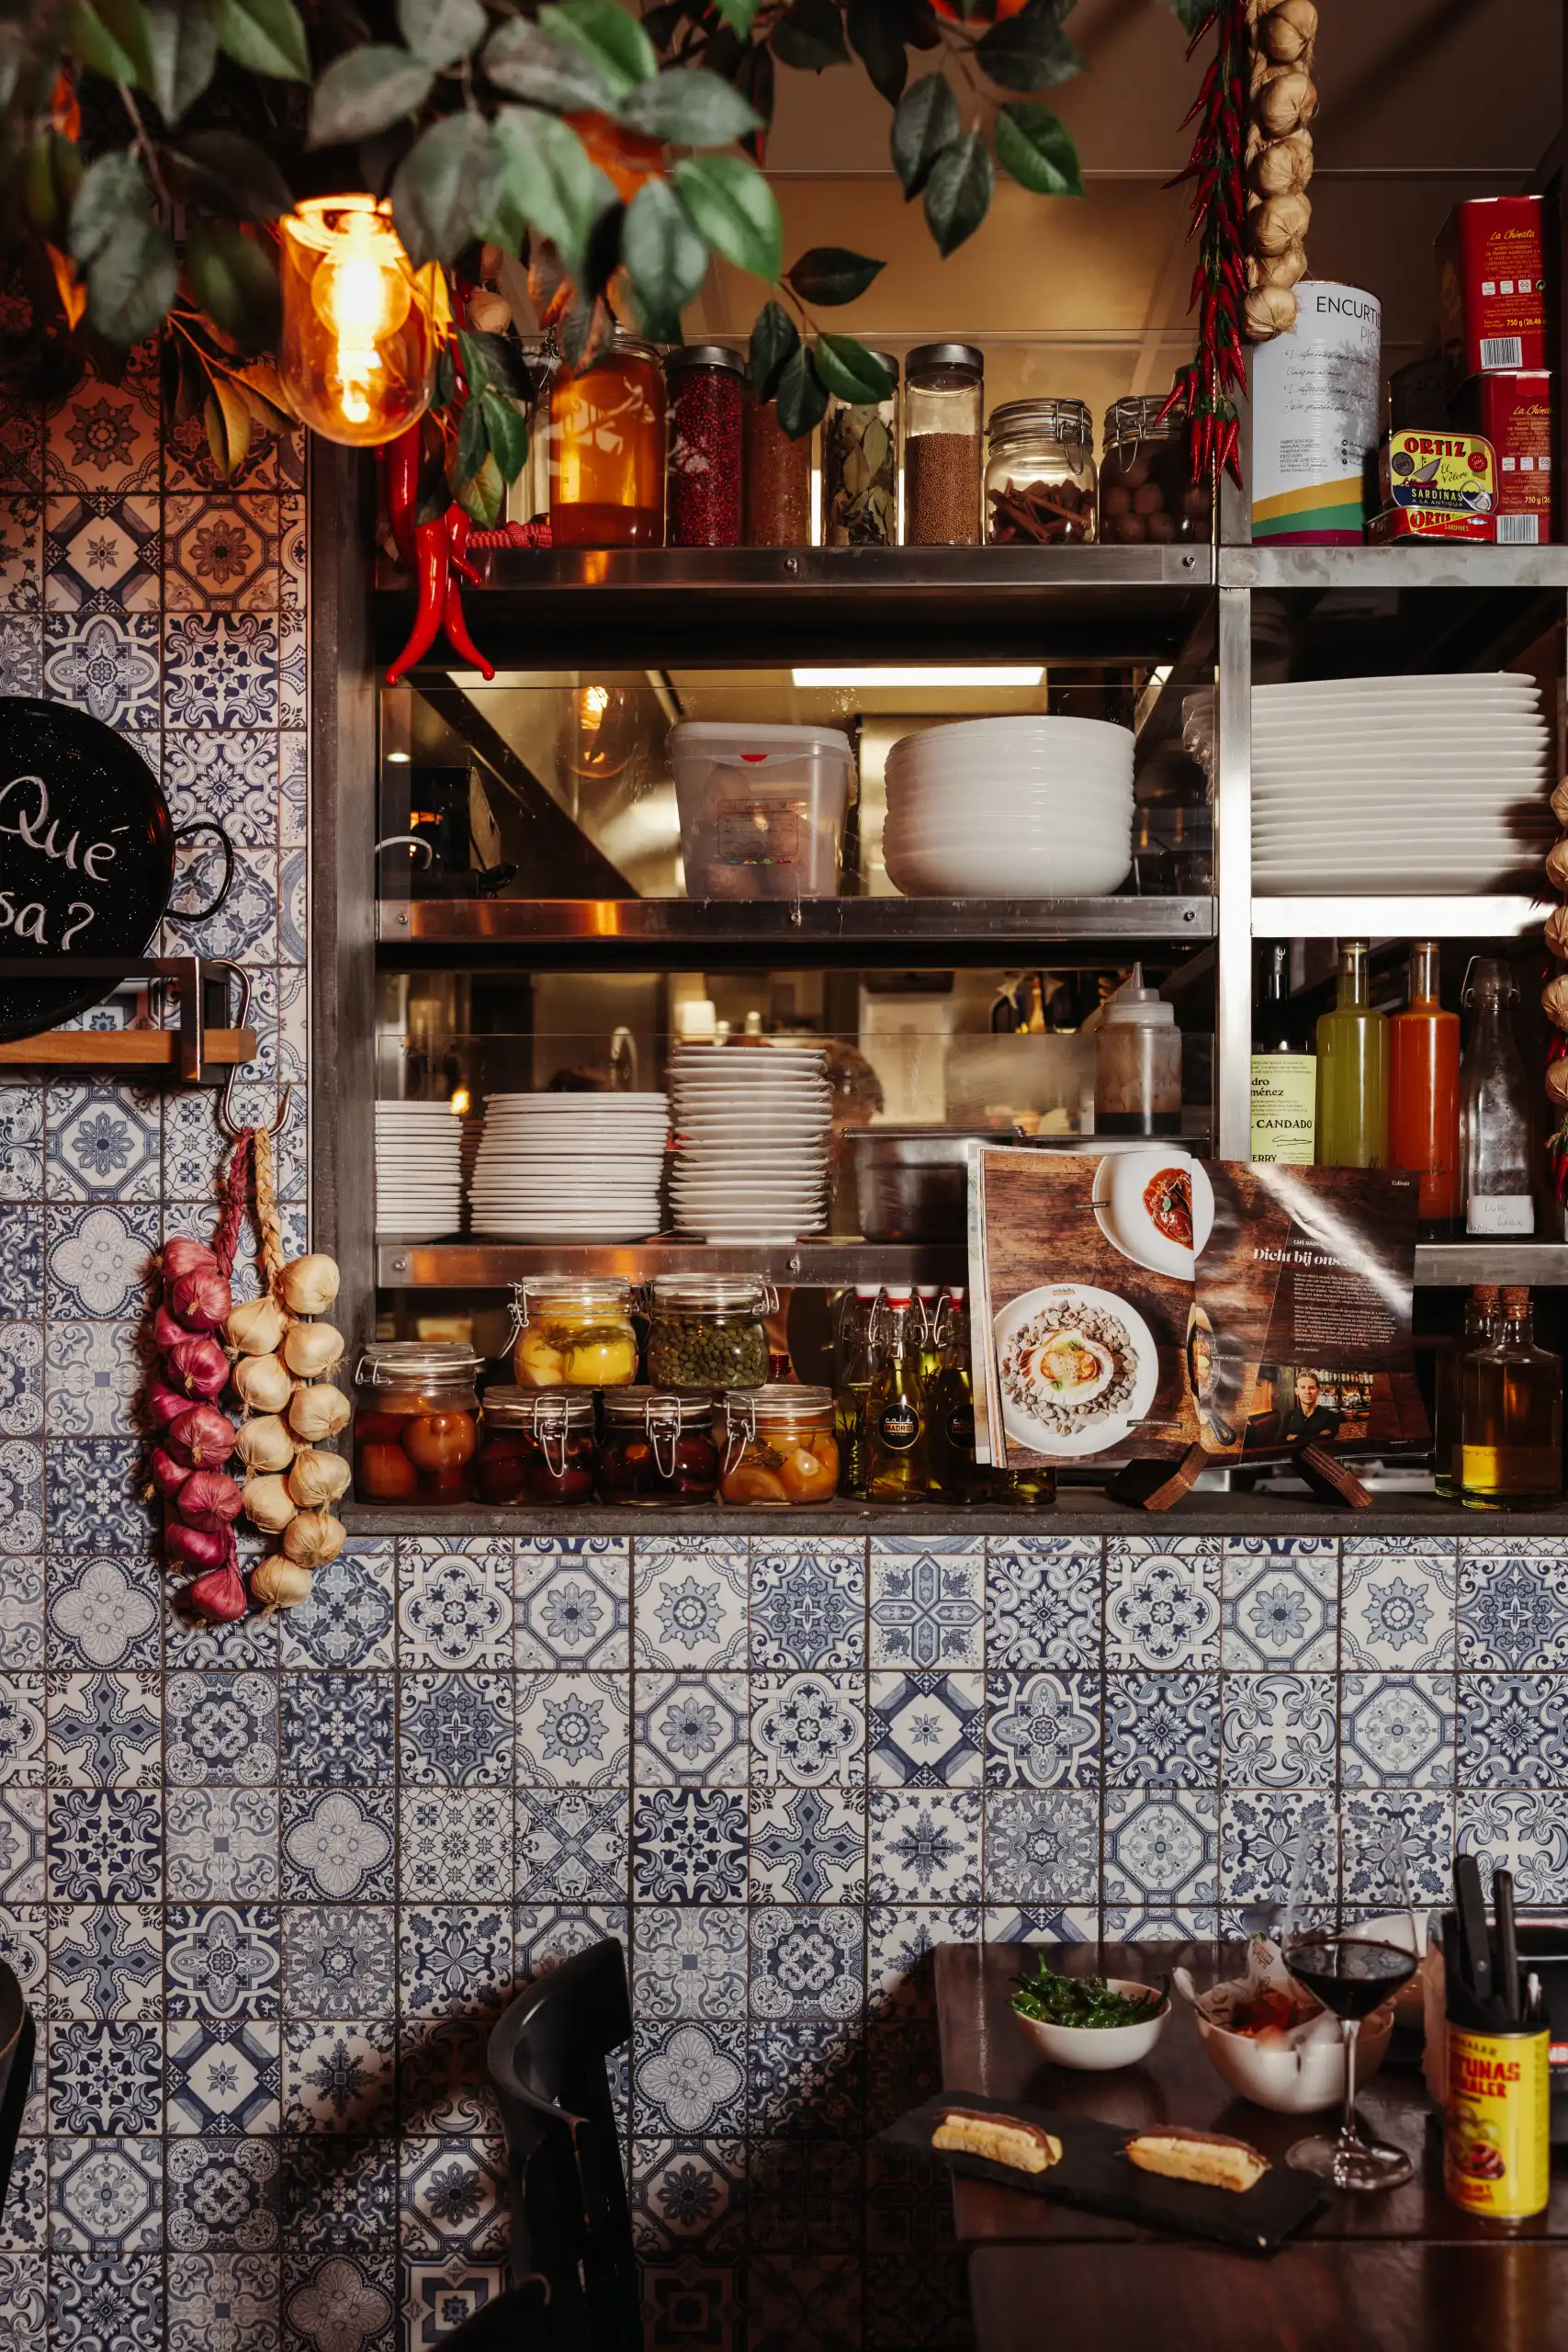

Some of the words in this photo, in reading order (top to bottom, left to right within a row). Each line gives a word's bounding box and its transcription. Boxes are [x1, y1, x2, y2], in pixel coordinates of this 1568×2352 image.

[1490, 231, 1501, 240] La
[1504, 228, 1535, 240] Chinata
[1506, 319, 1517, 327] 750
[1513, 405, 1524, 415] La
[1404, 436, 1467, 458] ORTIZ
[1441, 462, 1450, 474] El
[1411, 488, 1463, 502] SARDINAS
[1444, 524, 1470, 532] SARDINES
[0, 890, 95, 951] sa?
[1252, 1078, 1269, 1086] dro
[1251, 1088, 1285, 1096] ménez
[1257, 1119, 1312, 1129] CANDADO
[1252, 1154, 1277, 1162] ERRY
[1253, 1248, 1291, 1262] Dicht
[1293, 1250, 1313, 1267] bij
[1459, 2054, 1521, 2082] TUNAS
